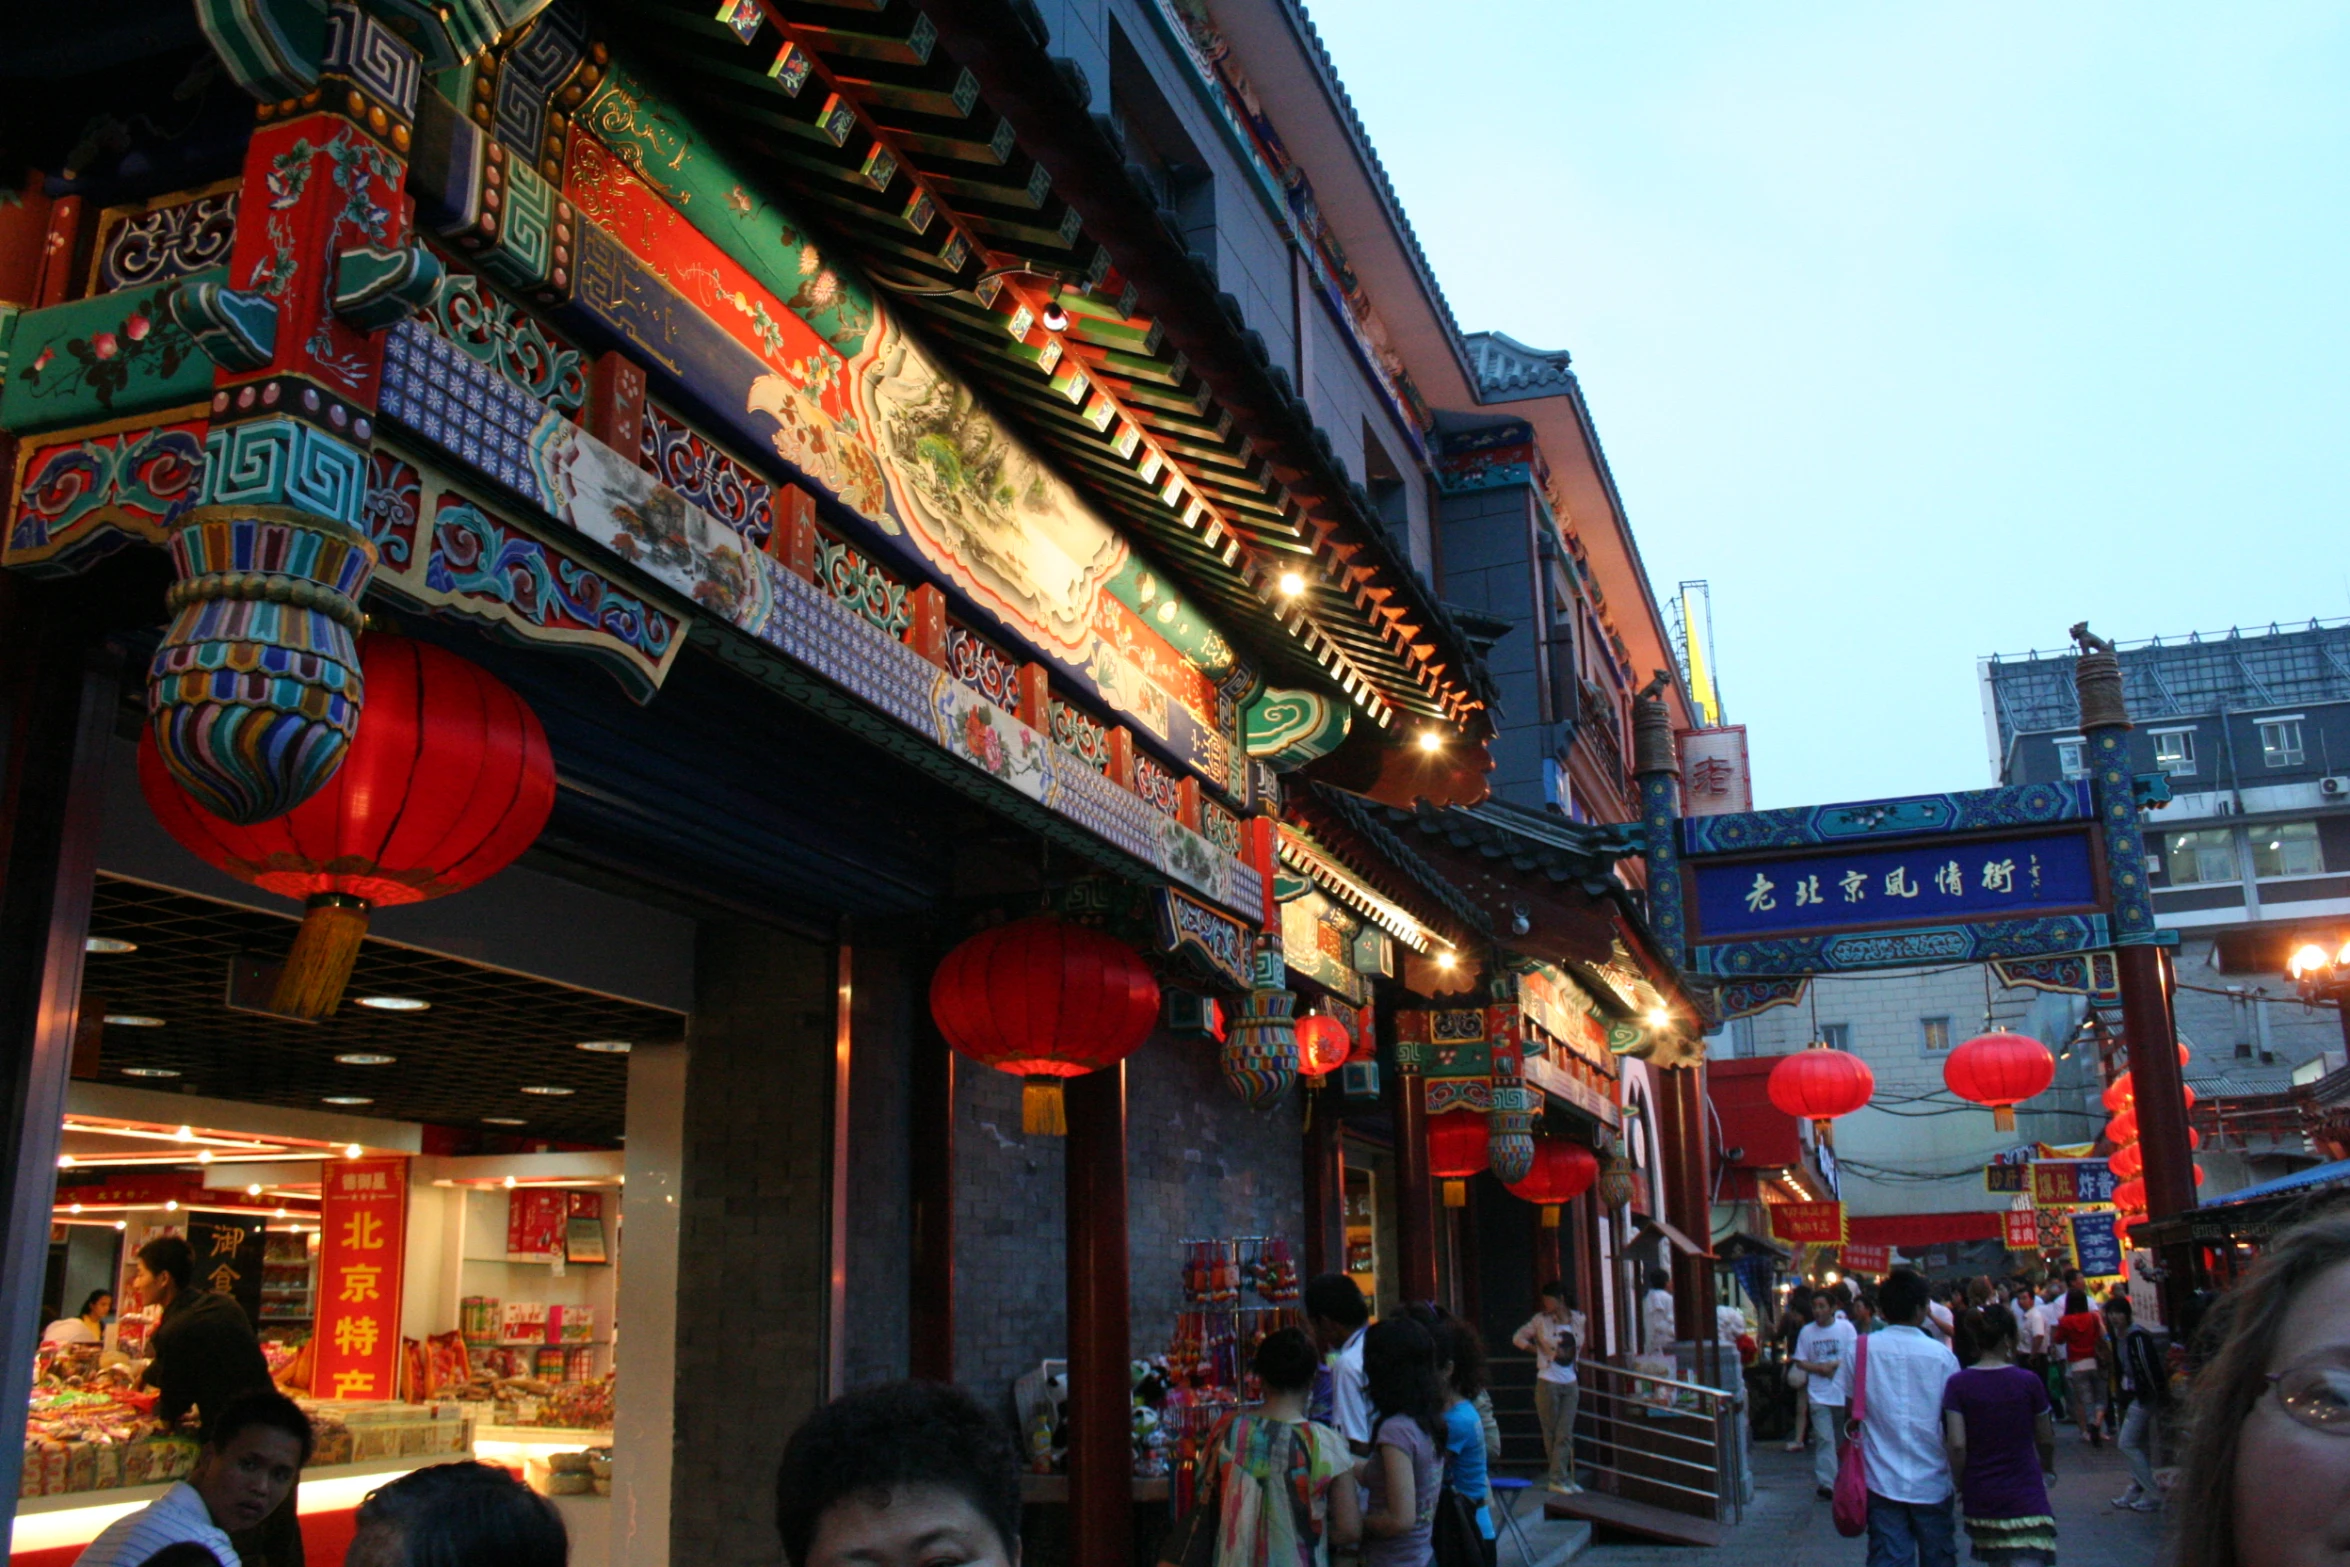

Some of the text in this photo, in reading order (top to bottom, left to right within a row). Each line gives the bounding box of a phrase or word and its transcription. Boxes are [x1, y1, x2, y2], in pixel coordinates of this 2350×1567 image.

[2078, 1171, 2118, 1199] 炸酱
[332, 1210, 385, 1400] 北京特产
